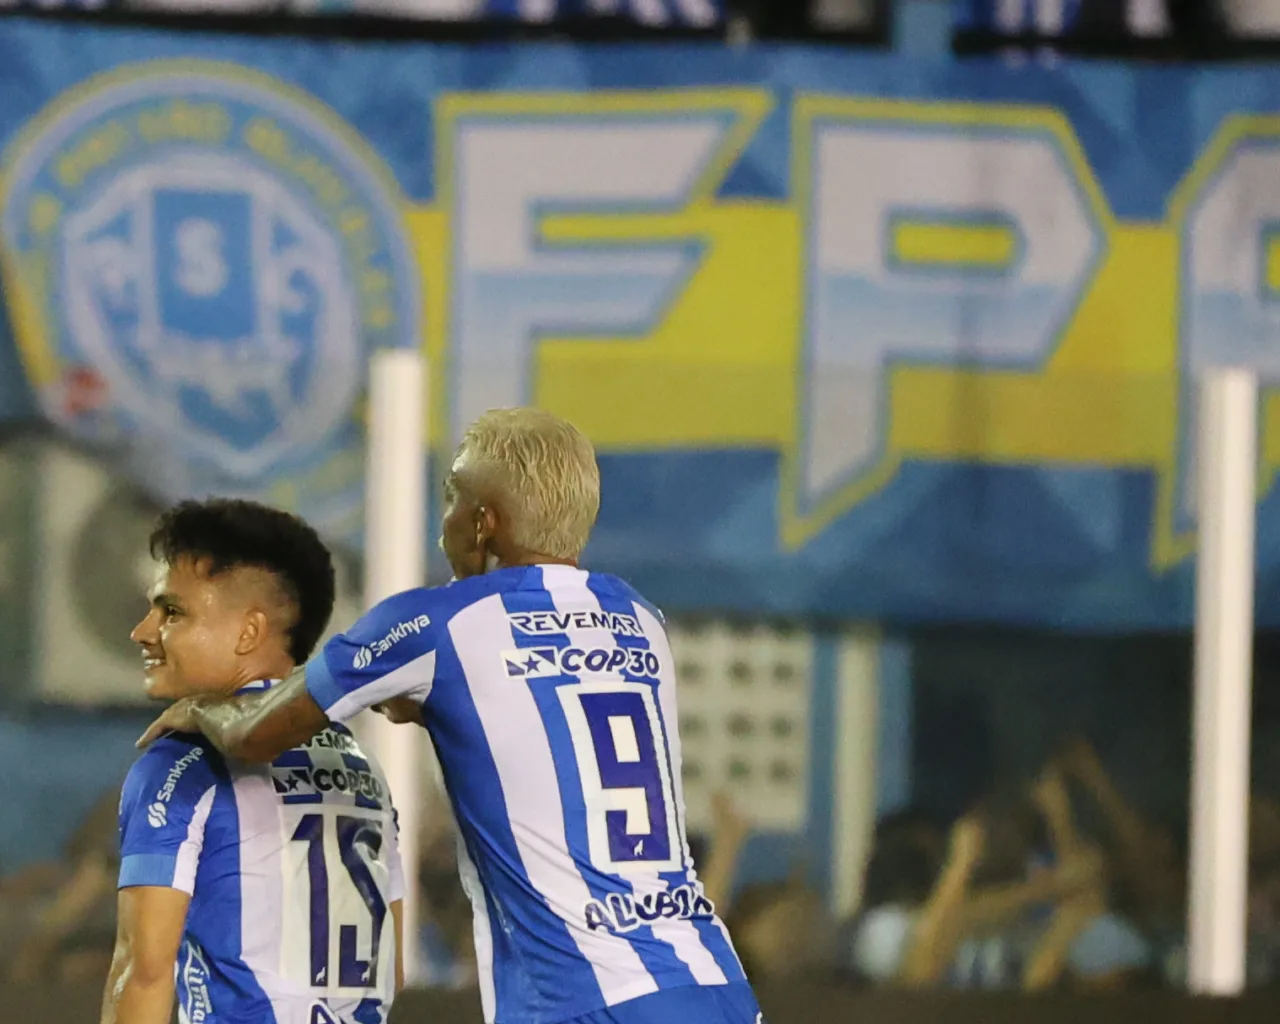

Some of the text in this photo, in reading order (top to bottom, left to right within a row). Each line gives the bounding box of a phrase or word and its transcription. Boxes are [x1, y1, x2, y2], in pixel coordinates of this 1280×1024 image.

[371, 614, 431, 657] Sankhya
[510, 611, 645, 636] REVEMAR
[157, 746, 205, 803] Sankhya
[577, 690, 671, 864] 9
[290, 813, 387, 988] 15
